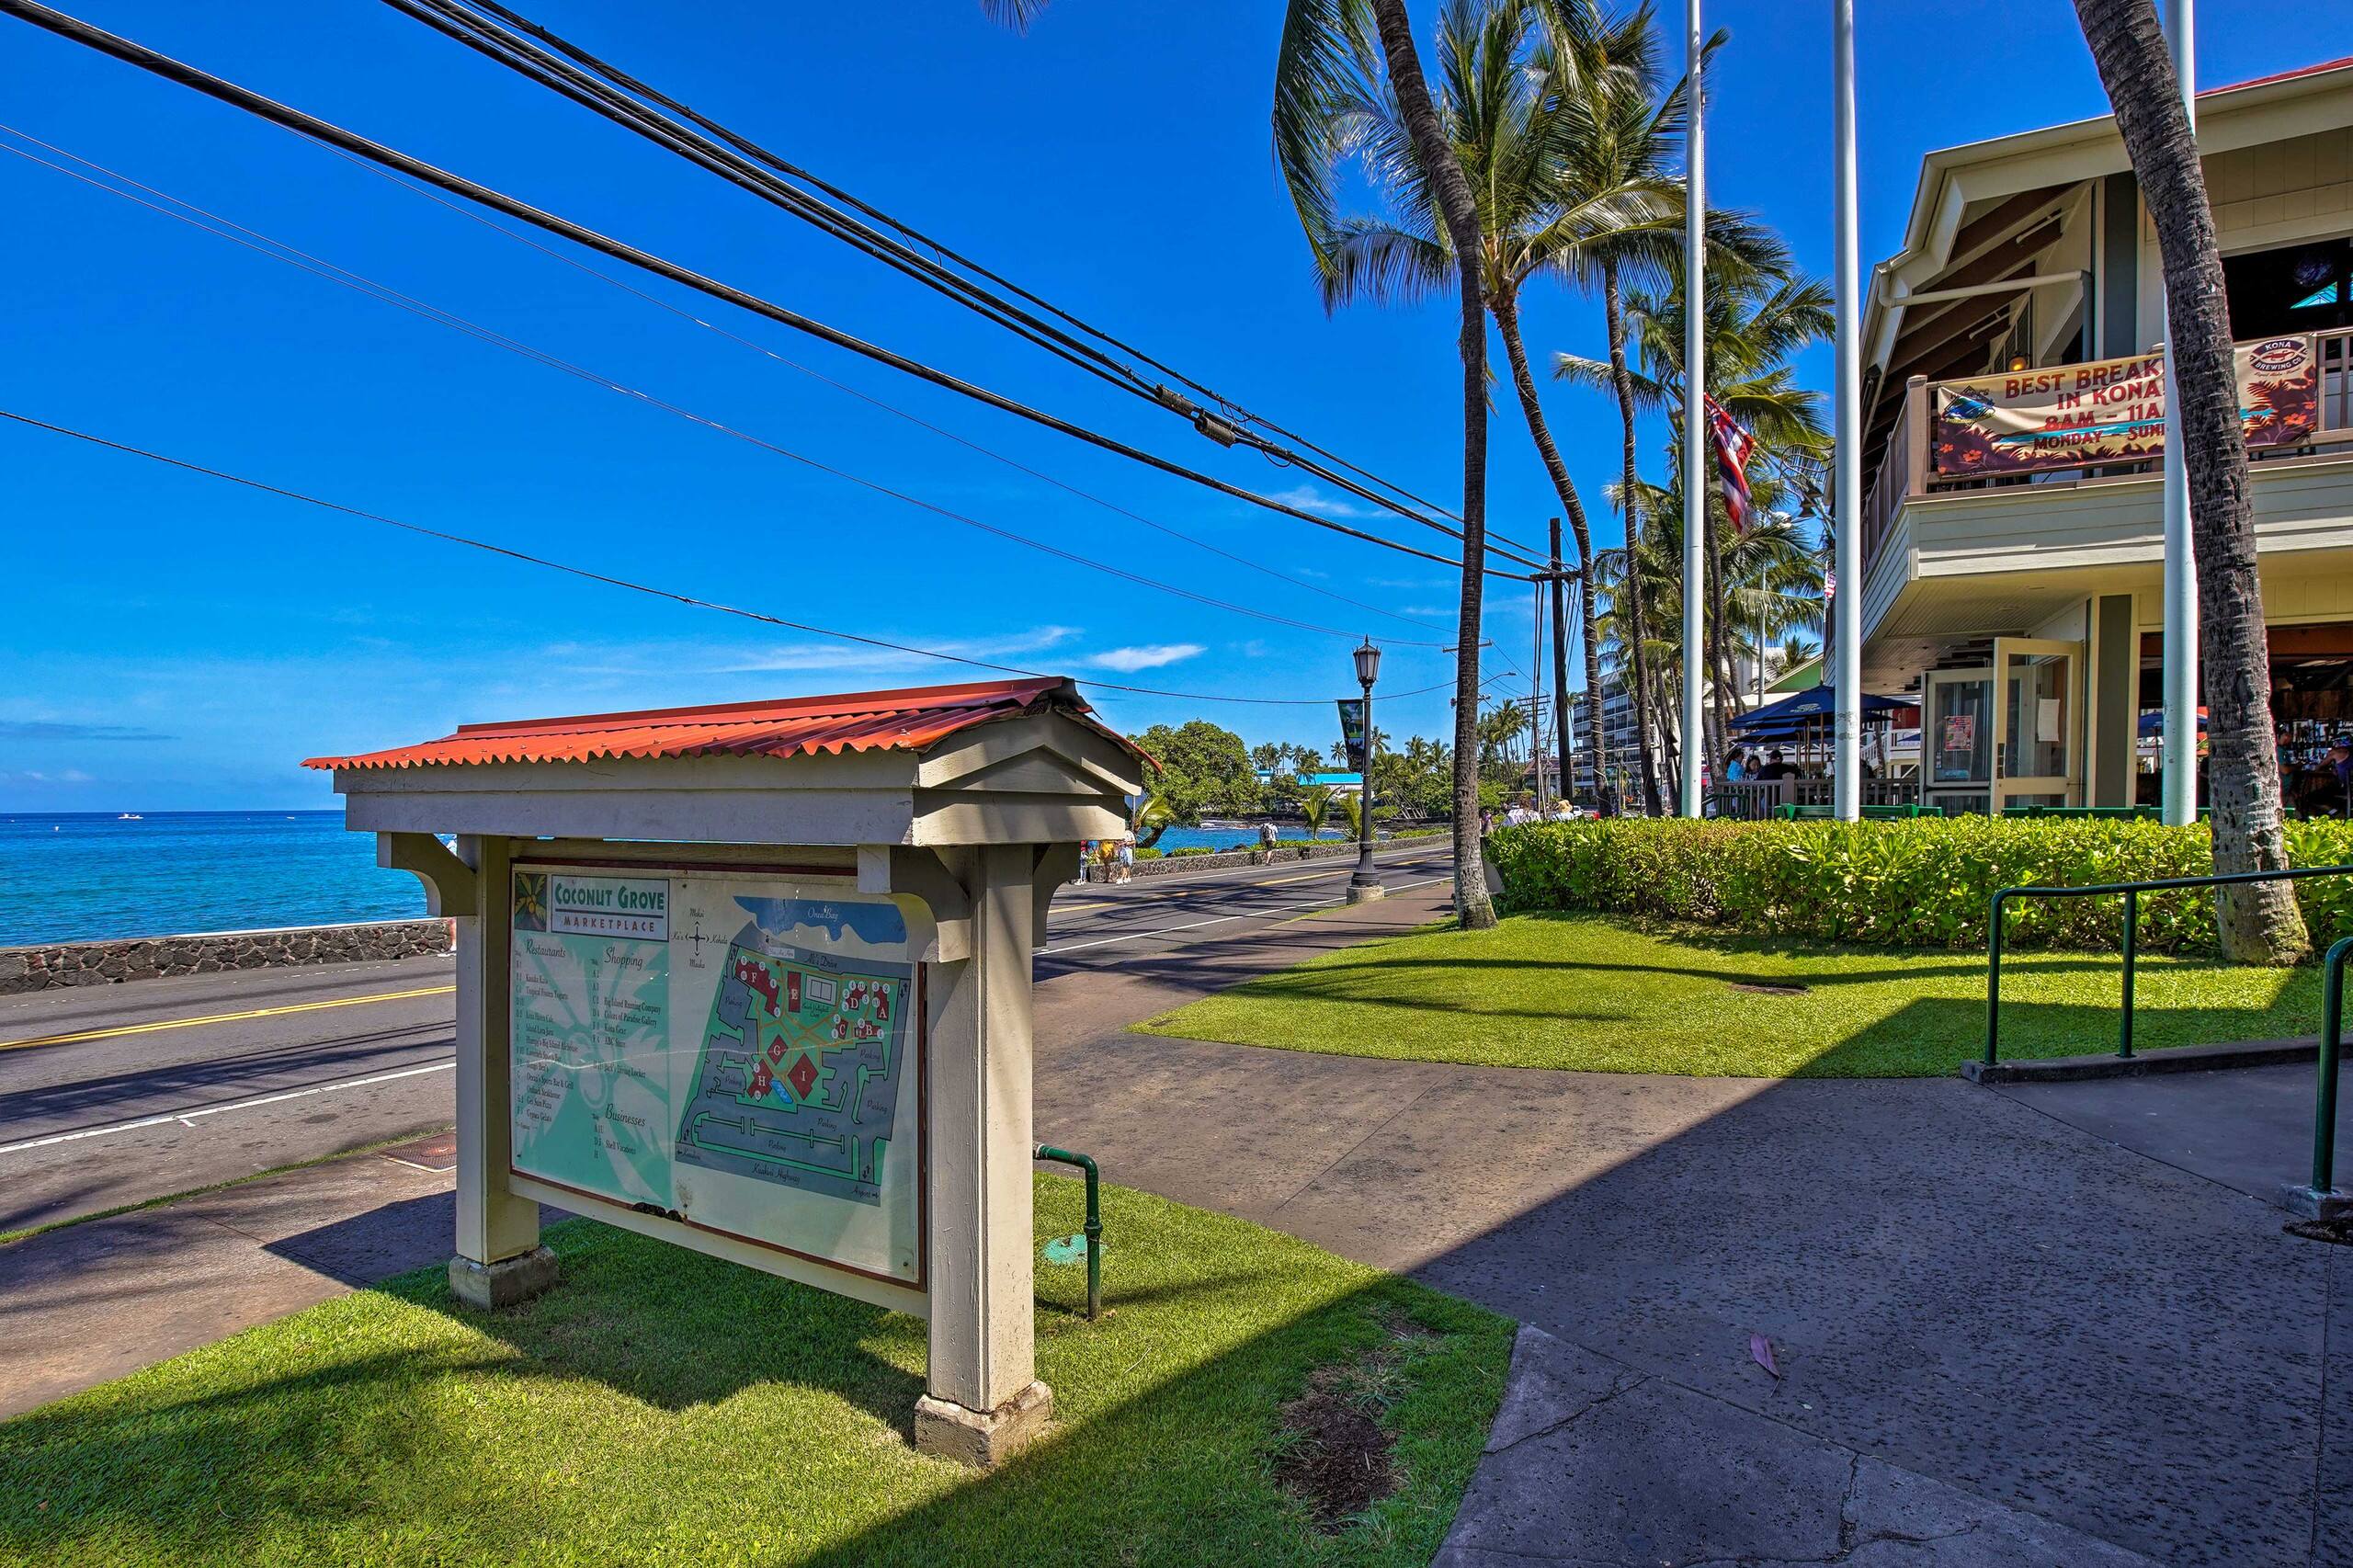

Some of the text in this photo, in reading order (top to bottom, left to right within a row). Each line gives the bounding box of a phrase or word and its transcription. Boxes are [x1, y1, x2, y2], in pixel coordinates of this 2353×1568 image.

[2265, 341, 2291, 350] KONA
[2255, 361, 2291, 370] BREWING
[2006, 358, 2165, 399] BEST BREAK
[2057, 391, 2081, 411] IN
[2044, 411, 2097, 431] 8AM
[2127, 403, 2165, 422] 11A
[2034, 430, 2104, 451] MONDAY
[555, 882, 665, 910] COCONUT GROVE
[563, 915, 655, 933] MARKETPLACE
[525, 938, 566, 958] Restaurants
[604, 946, 643, 971] Shopping
[752, 971, 757, 983] F
[791, 988, 798, 1000] E
[851, 997, 858, 1009] D
[879, 1006, 887, 1018] A
[839, 1024, 846, 1036] C
[866, 1025, 872, 1036] B
[773, 1045, 780, 1056] G
[758, 1075, 766, 1086] H
[800, 1070, 806, 1082] I
[606, 1103, 646, 1127] Businesses
